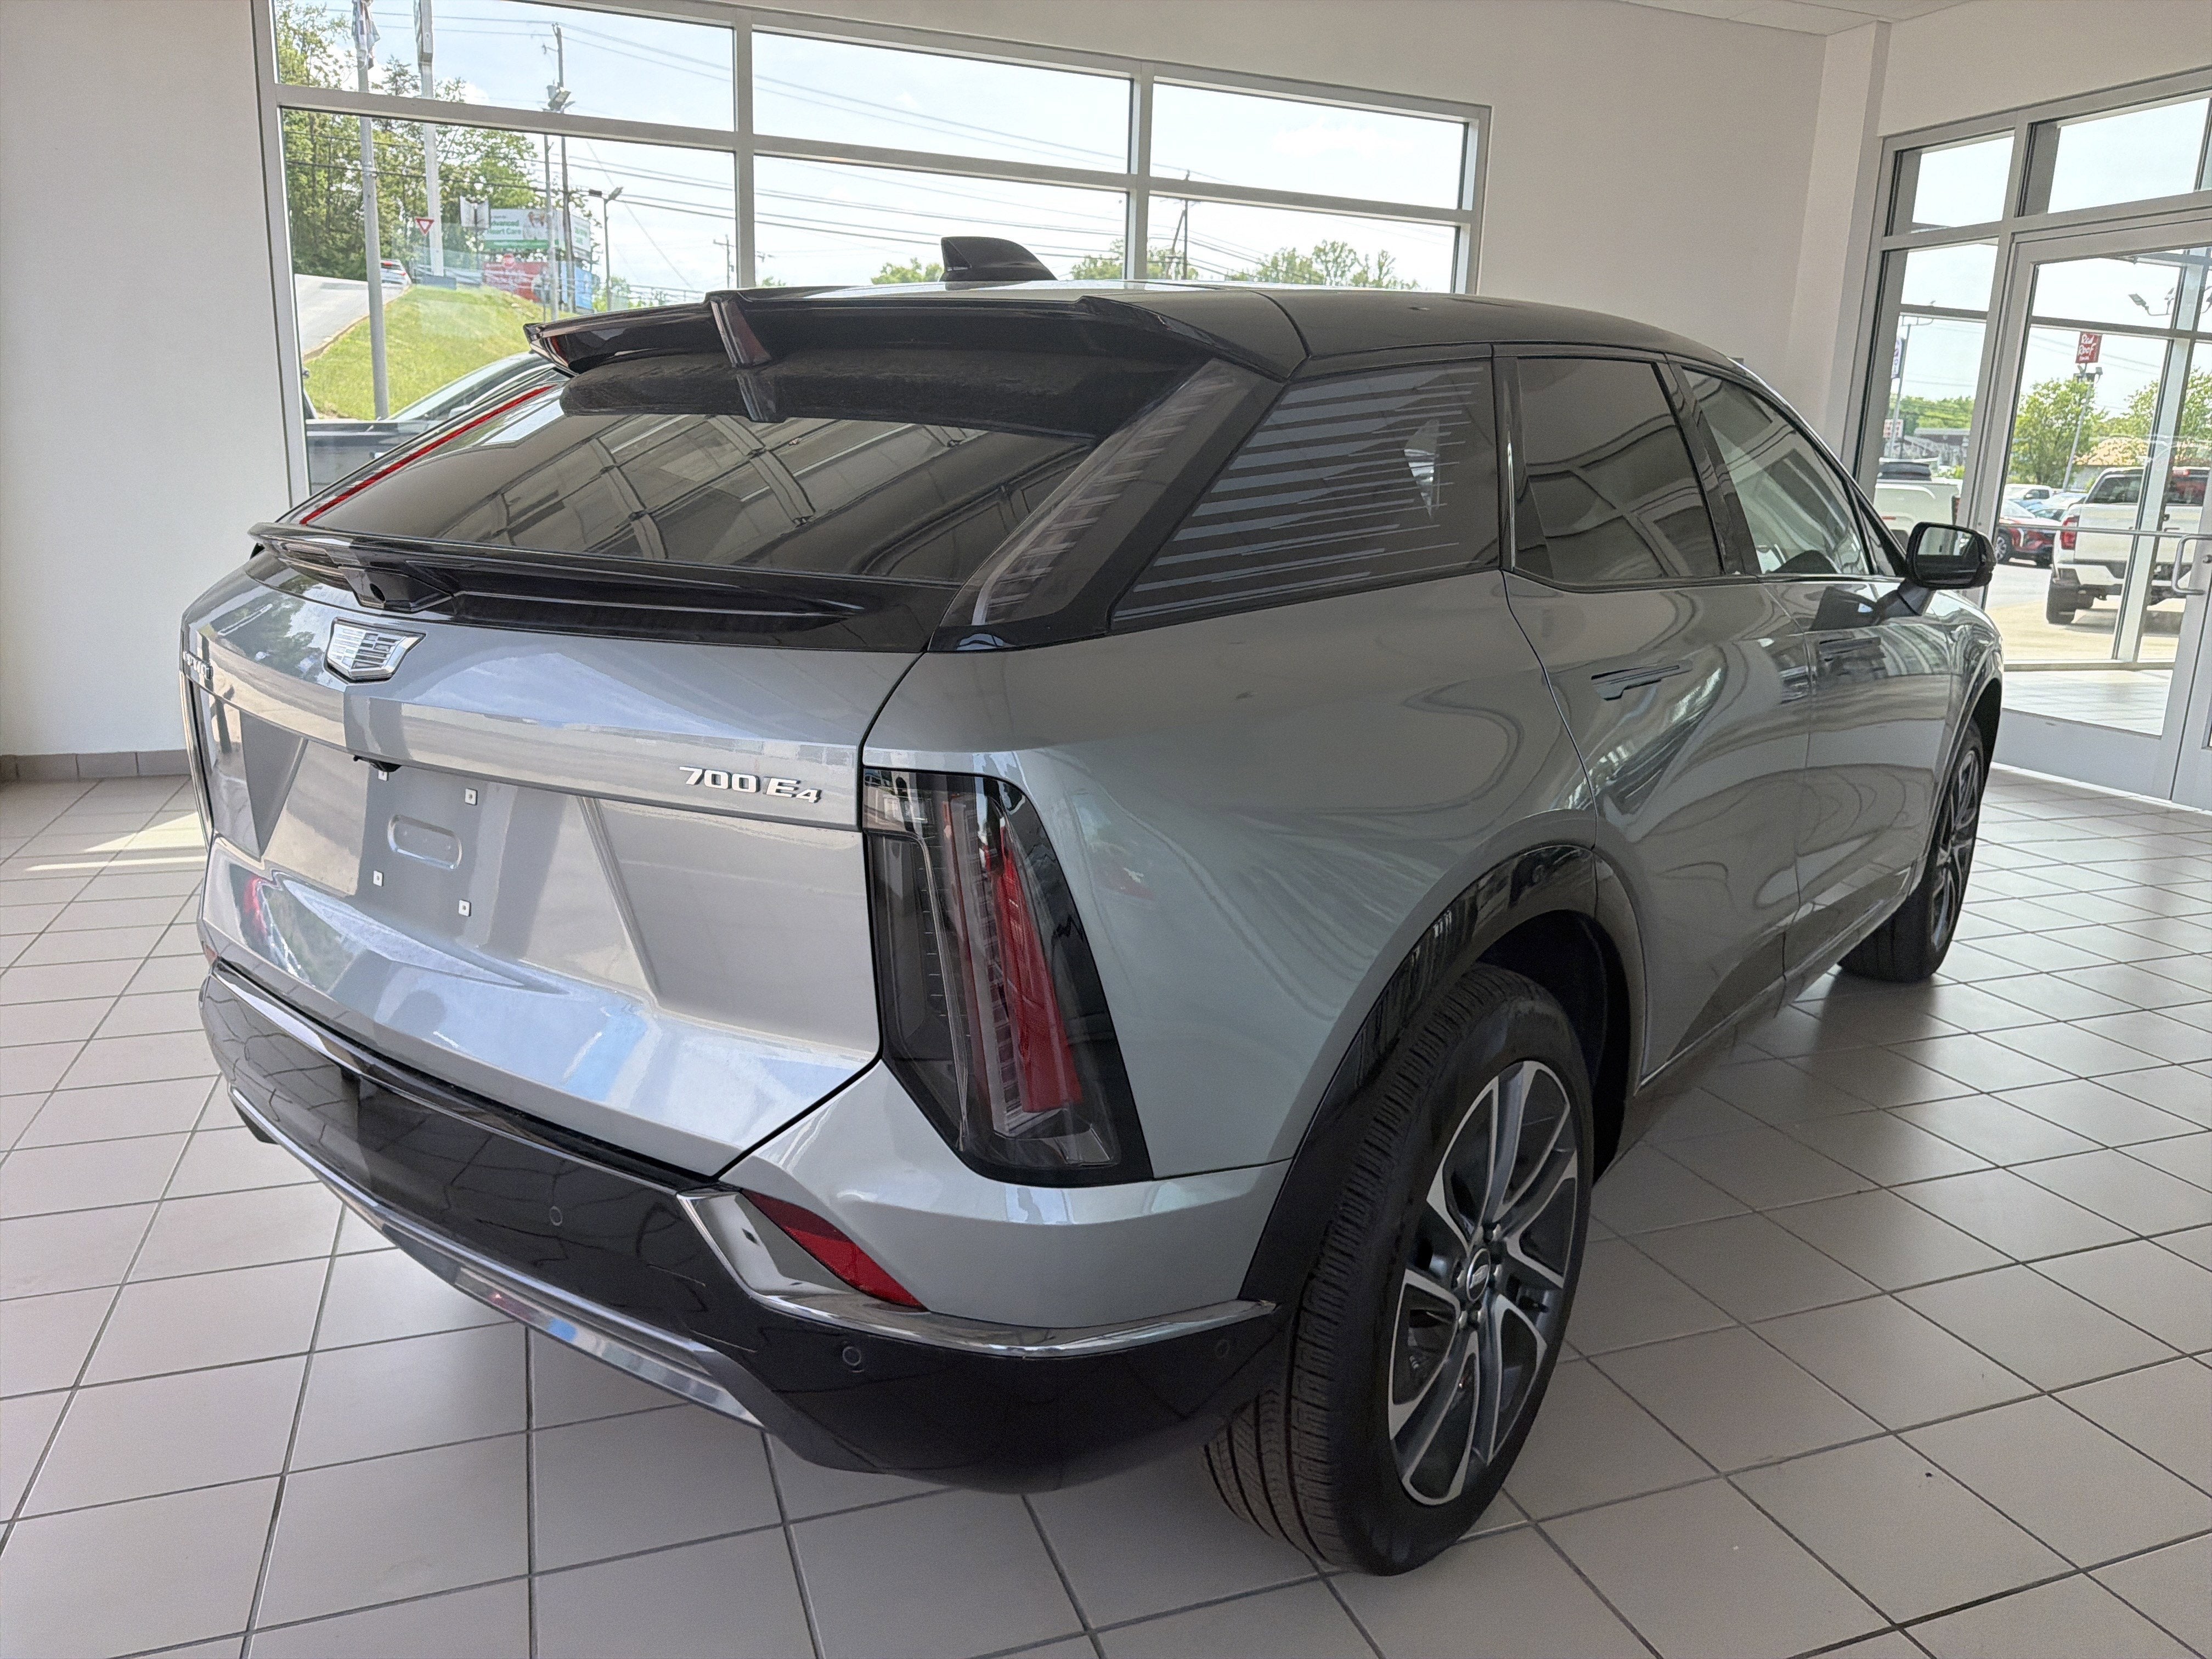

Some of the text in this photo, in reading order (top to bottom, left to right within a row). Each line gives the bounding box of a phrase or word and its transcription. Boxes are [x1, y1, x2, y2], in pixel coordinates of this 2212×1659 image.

[2080, 334, 2095, 344] Red
[2077, 343, 2096, 356] Roof
[679, 766, 822, 803] 700 E4
